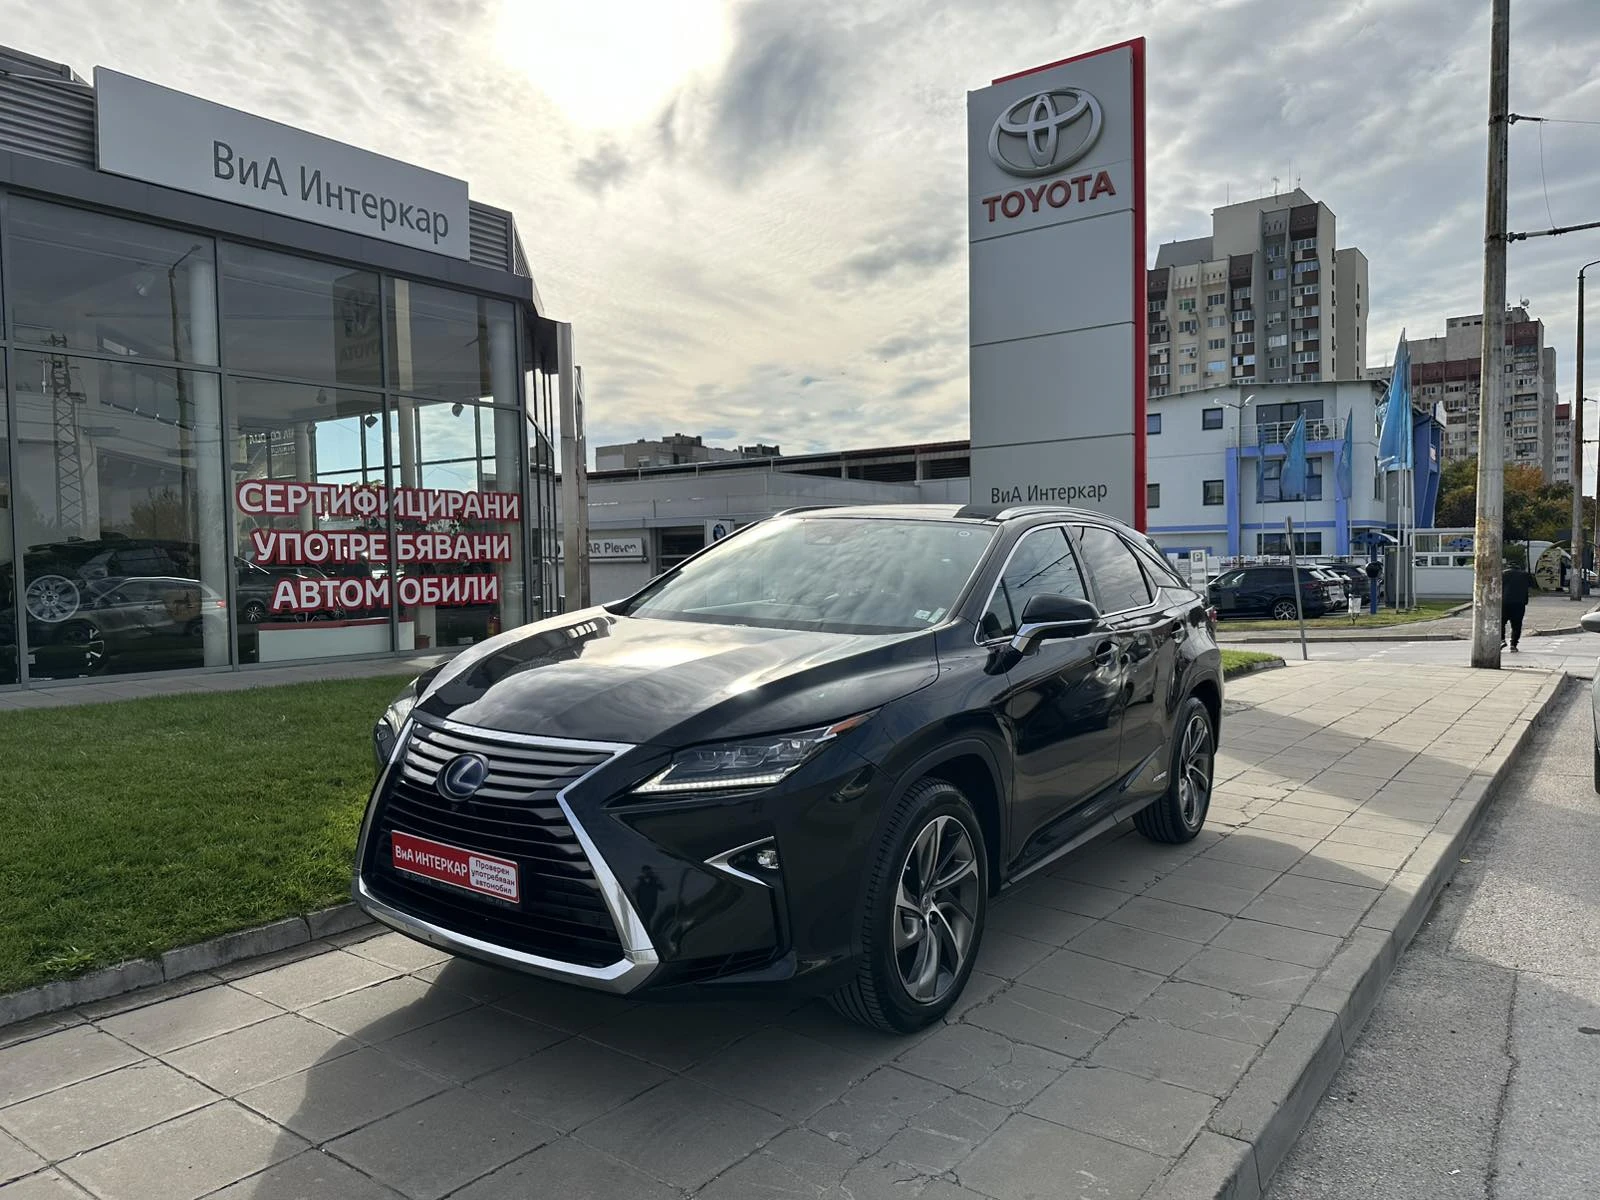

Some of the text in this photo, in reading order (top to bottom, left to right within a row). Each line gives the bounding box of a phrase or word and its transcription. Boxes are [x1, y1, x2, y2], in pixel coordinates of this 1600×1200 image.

[213, 140, 449, 244] ВиА Интеркар
[982, 170, 1116, 222] TOYOTA
[237, 481, 520, 522] СЕРТИФИЦИРАНИ
[991, 484, 1108, 504] ВиА Интеркар
[587, 542, 602, 554] AR
[395, 845, 468, 877] ВиА ИНТЕРКАР
[475, 859, 510, 876] Проверен
[475, 878, 512, 895] автомобил
